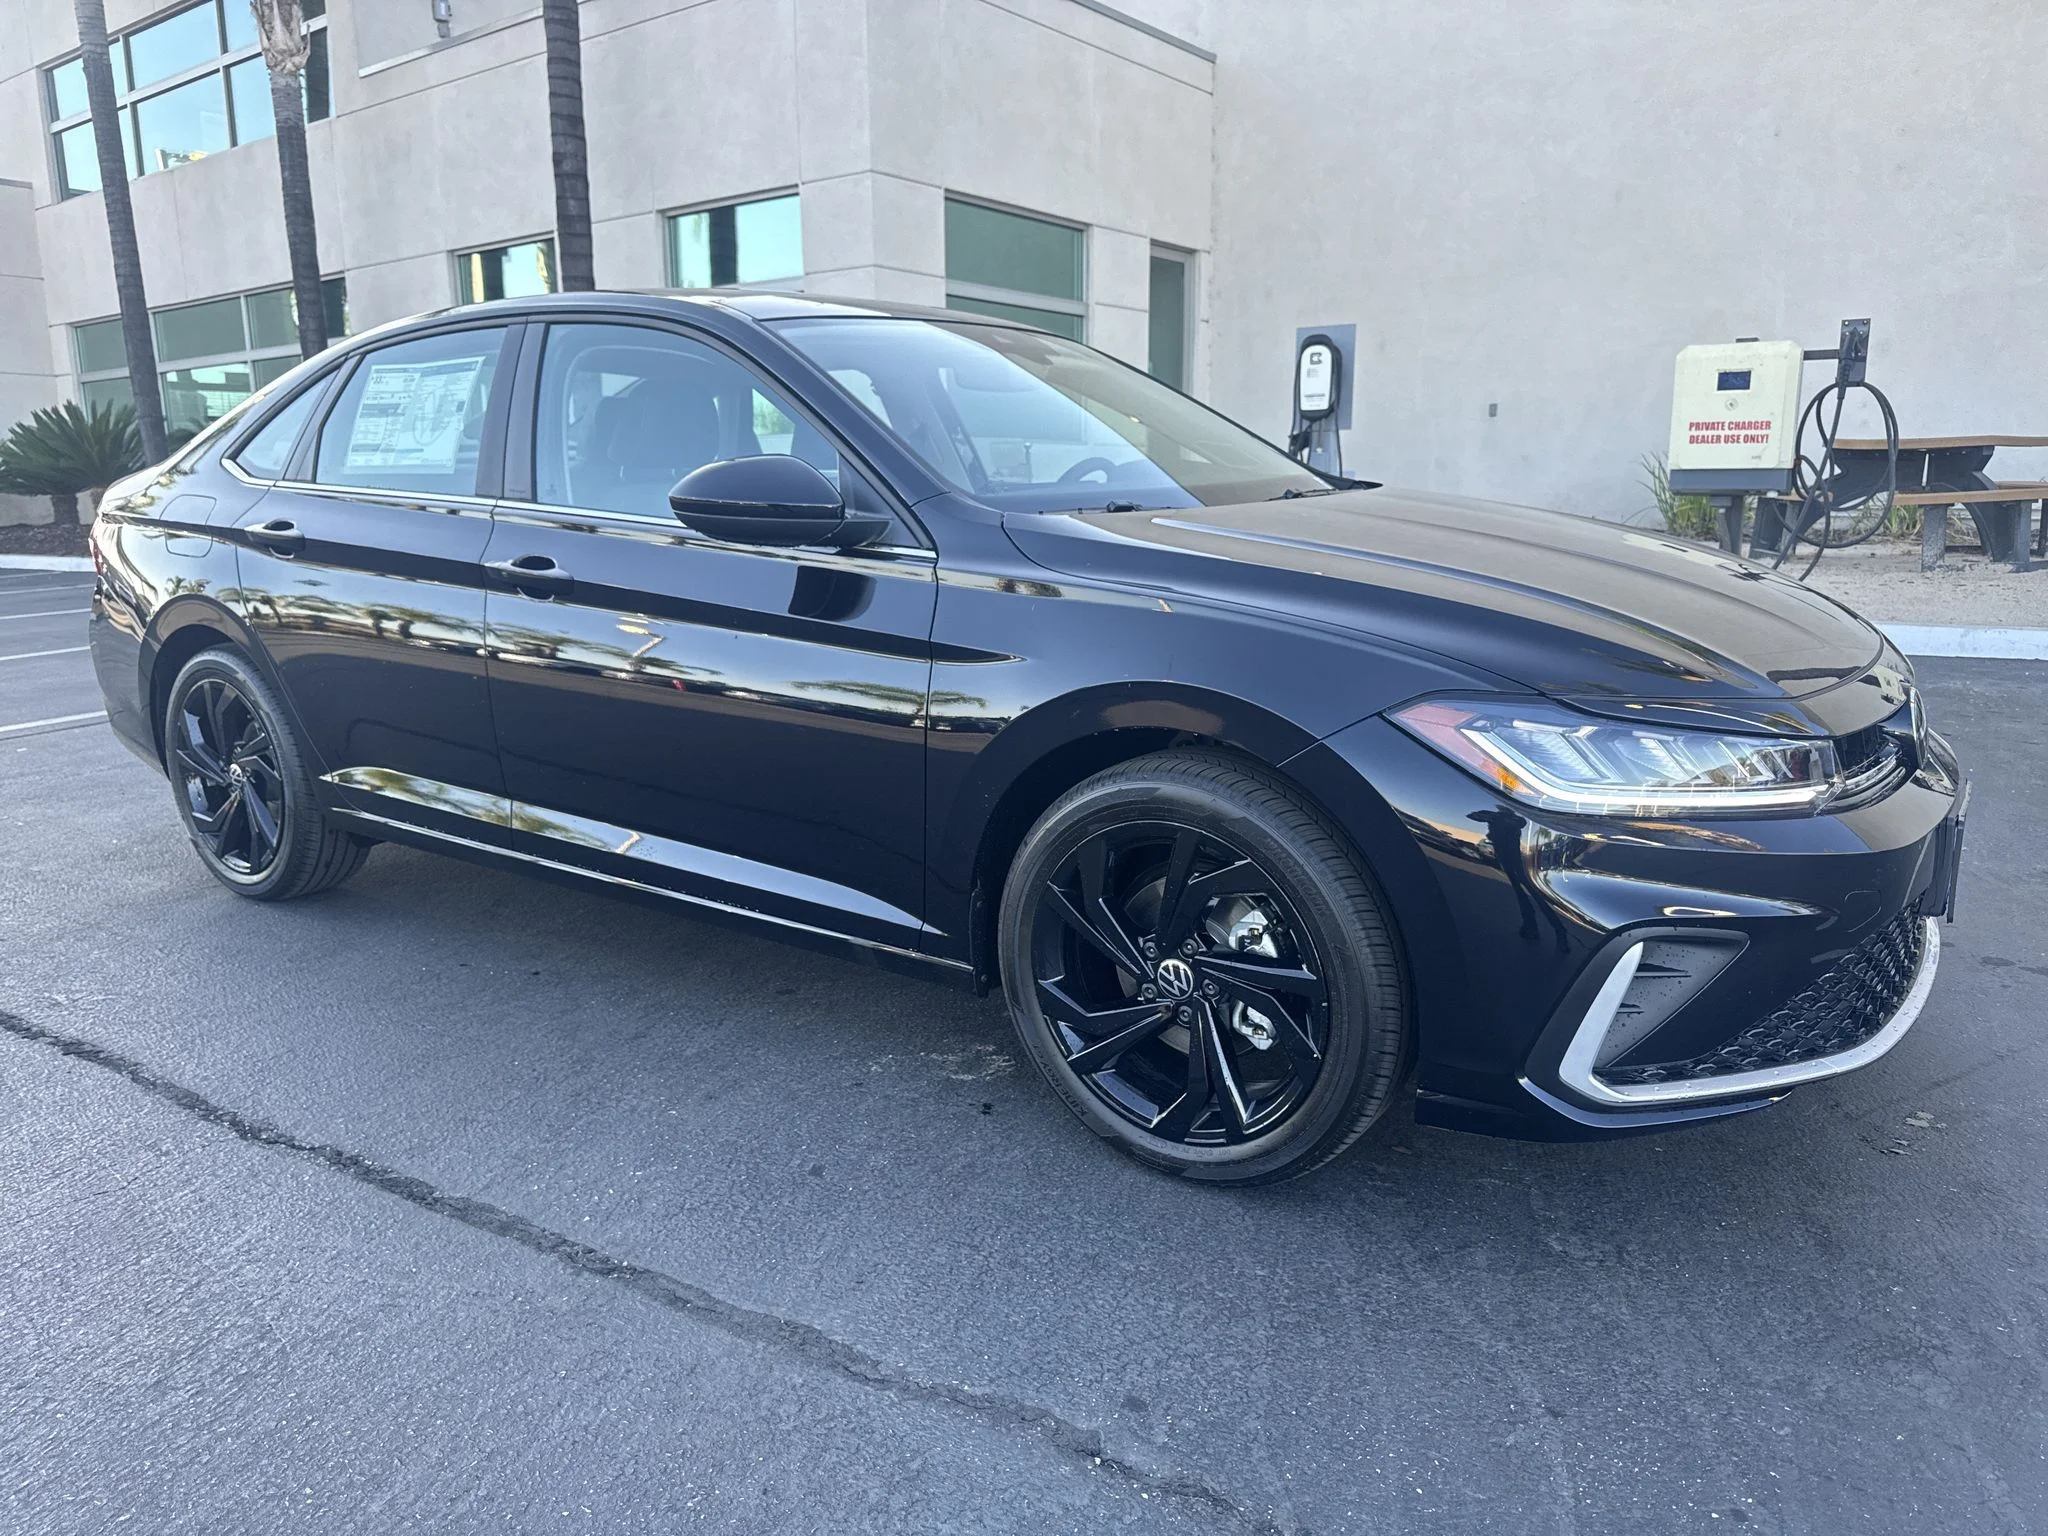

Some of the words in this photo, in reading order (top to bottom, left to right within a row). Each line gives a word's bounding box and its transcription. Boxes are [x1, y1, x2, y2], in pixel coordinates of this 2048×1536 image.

[1688, 421, 1725, 431] PRIVATE
[1728, 420, 1771, 430] CHARGER
[1688, 434, 1721, 444] DEALER
[1723, 434, 1740, 444] USE
[1743, 434, 1769, 444] ONLY!
[1157, 959, 1193, 999] VW
